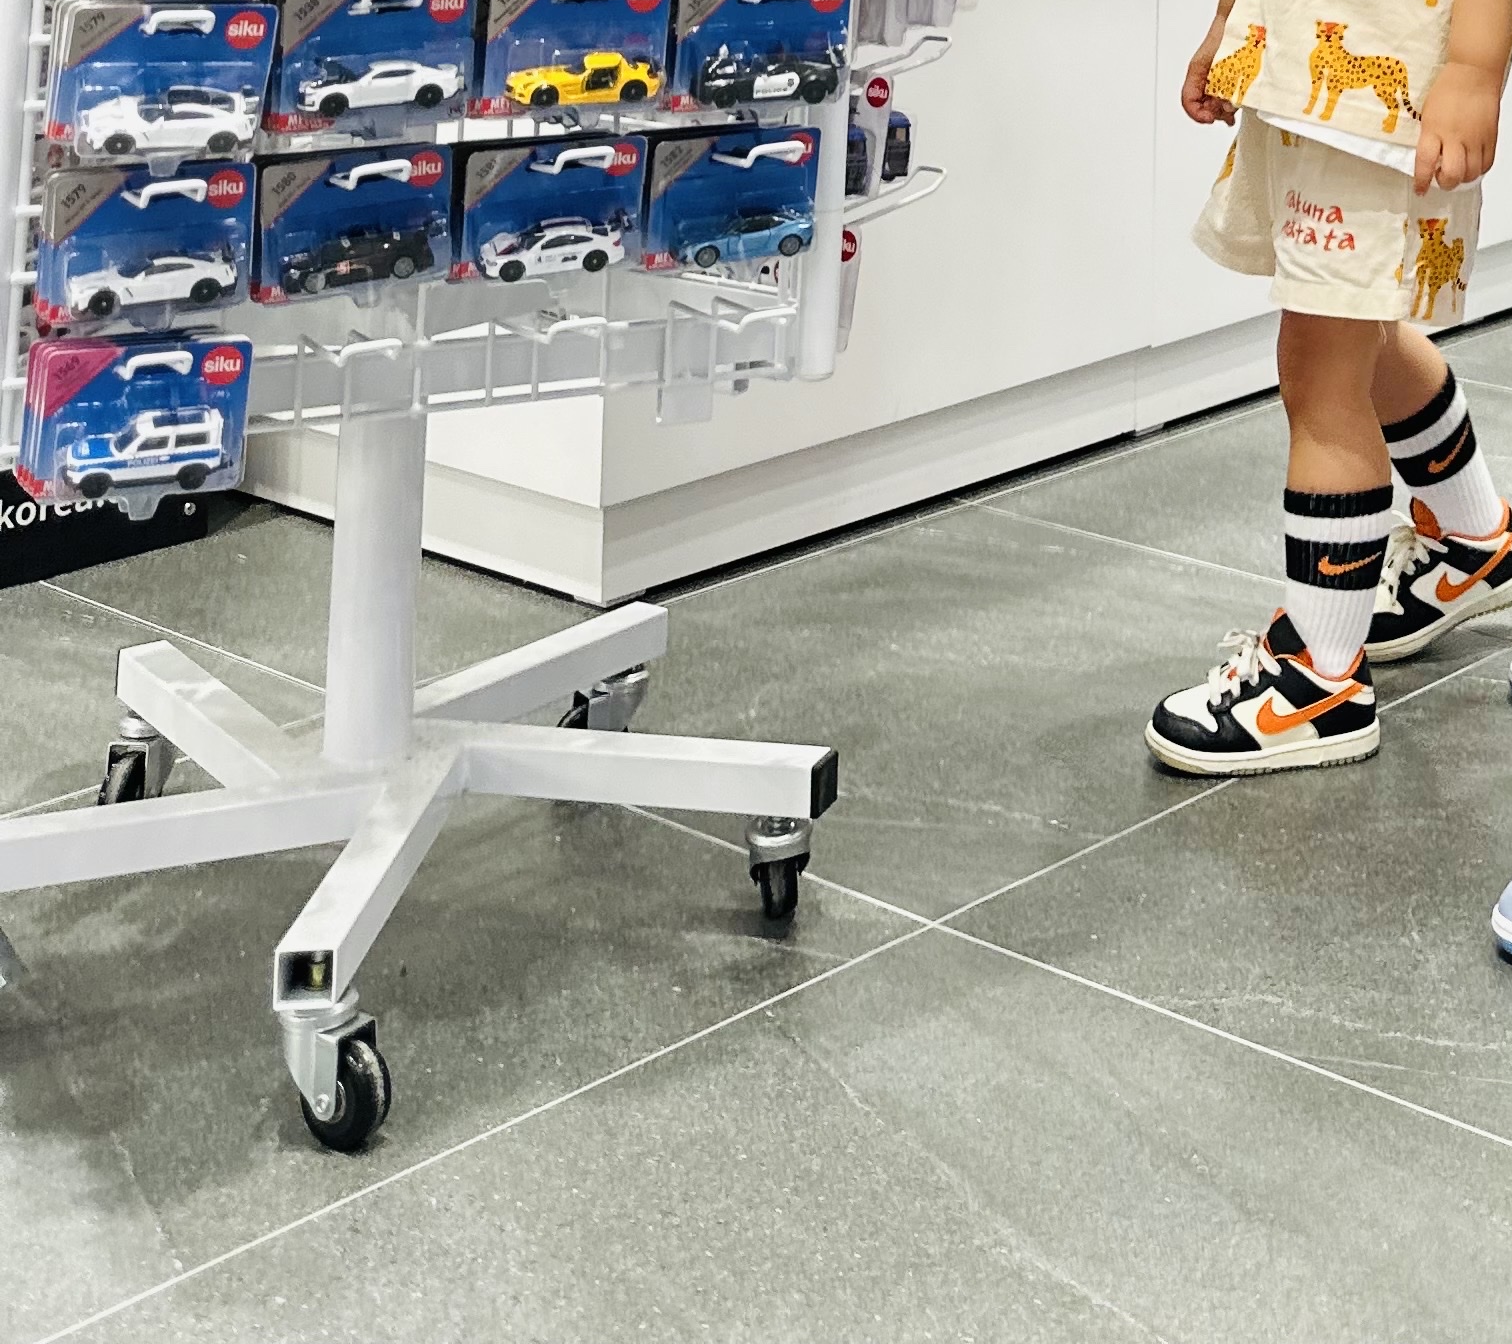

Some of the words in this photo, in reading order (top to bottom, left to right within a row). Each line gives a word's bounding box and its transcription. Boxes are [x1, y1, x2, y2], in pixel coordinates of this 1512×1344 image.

[227, 20, 266, 38] siku
[207, 178, 245, 196] siku
[203, 356, 241, 373] siku
